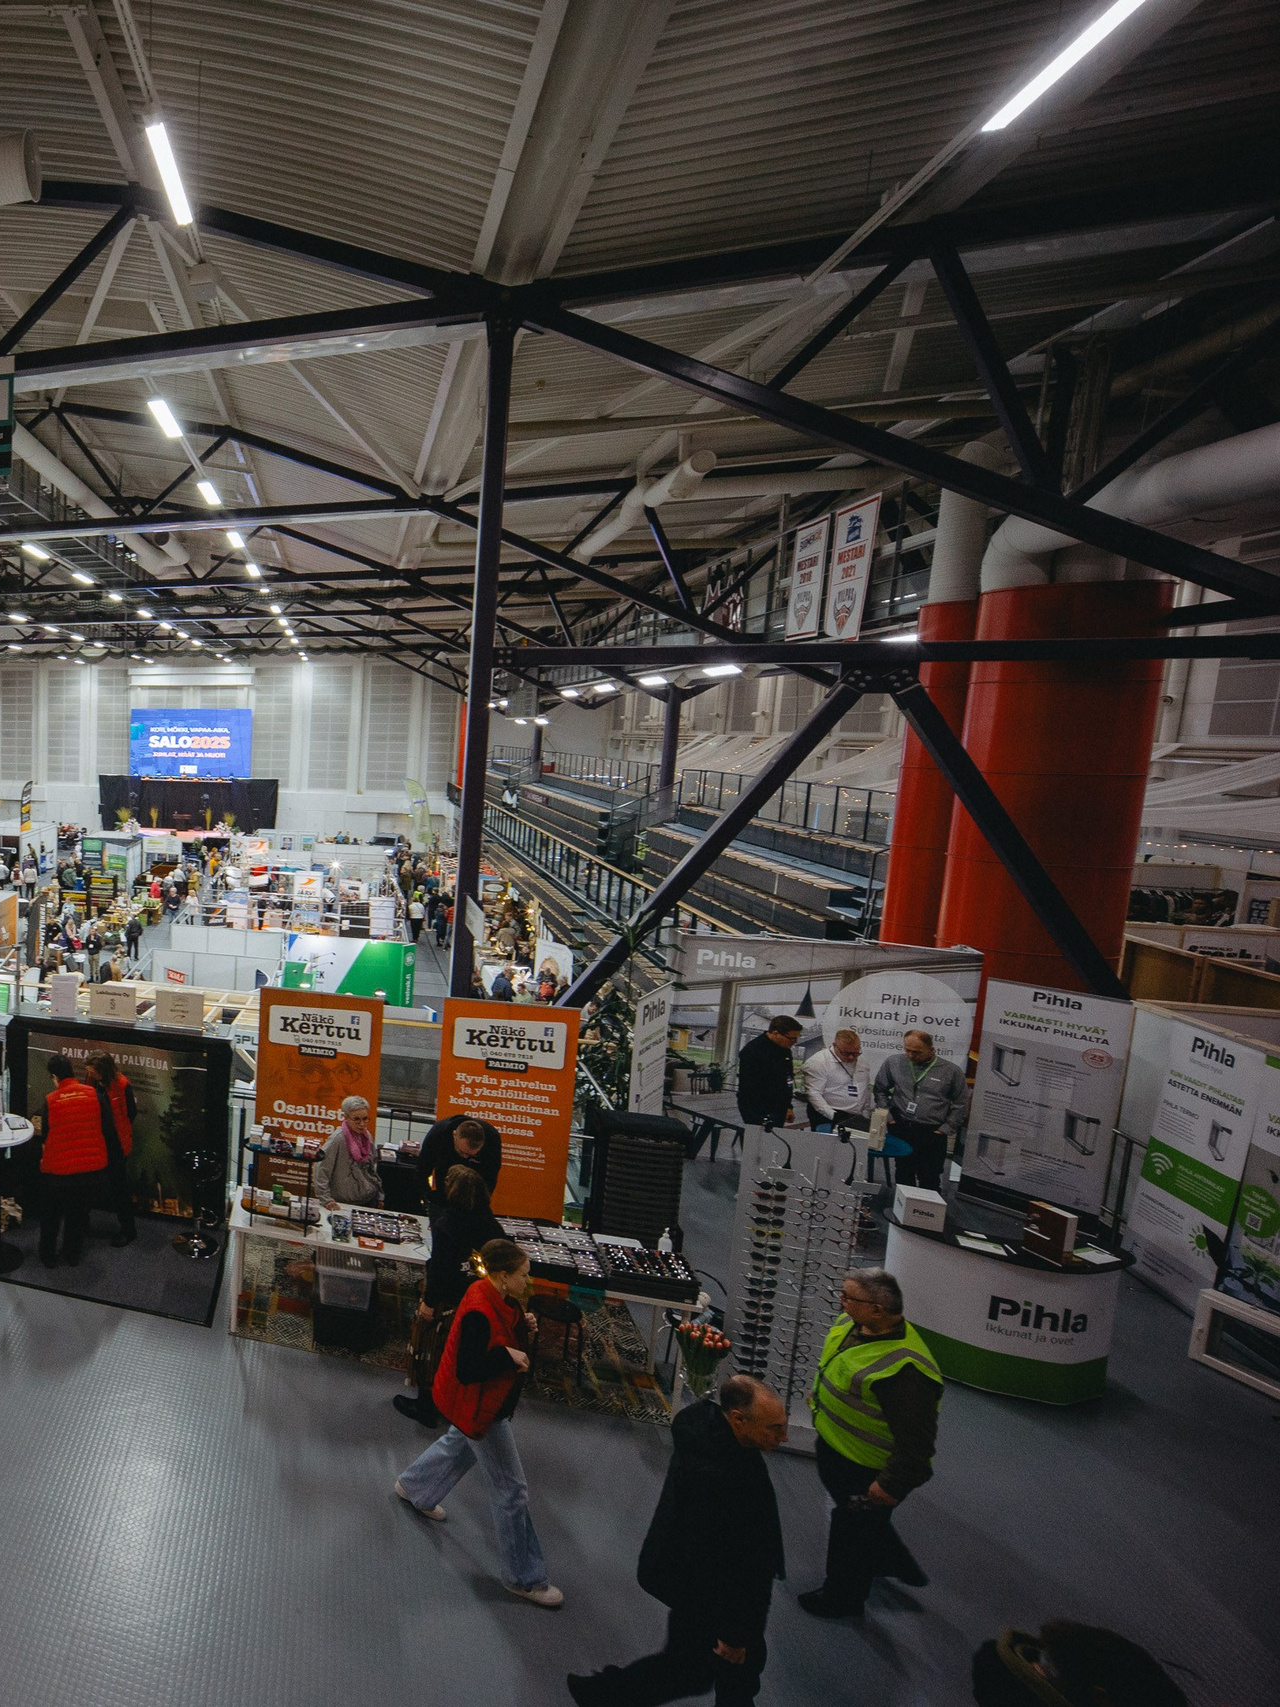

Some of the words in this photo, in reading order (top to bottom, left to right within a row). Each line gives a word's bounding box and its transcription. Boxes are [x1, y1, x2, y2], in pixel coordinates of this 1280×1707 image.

[837, 544, 866, 566] MESTARI
[148, 736, 230, 749] SALO2025
[697, 948, 756, 968] Pihla
[882, 993, 920, 1008] Pihla
[1032, 991, 1082, 1010] Pihla
[300, 1012, 334, 1024] Näkö
[642, 998, 666, 1026] Pihla
[839, 1006, 900, 1022] ikkunat
[902, 1010, 918, 1024] ja
[923, 1014, 960, 1028] ovet
[280, 1016, 362, 1041] Kerttu
[490, 1025, 526, 1037] Näkö
[850, 1025, 904, 1038] Suosituin
[1000, 1018, 1050, 1033] IKKUNAT
[1053, 1028, 1110, 1046] PIHLALTA
[1004, 1010, 1062, 1027] VARMASTI
[1065, 1022, 1108, 1036] HYVÄT
[300, 1046, 334, 1056] PAIMIO
[465, 1029, 555, 1054] Kerttu
[1090, 1054, 1104, 1063] 25
[1192, 1036, 1236, 1068] Pihla
[122, 1054, 168, 1071] PALVELUA
[488, 1060, 526, 1070] PAIMIO
[456, 1072, 498, 1086] Hyvän
[500, 1076, 557, 1092] palvelun
[1184, 1075, 1208, 1088] VAADIT
[1208, 1086, 1245, 1106] PIHLALTASI
[459, 1085, 472, 1096] ja
[474, 1086, 550, 1103] yksilöllisen
[1168, 1078, 1199, 1097] ASTETTA
[1200, 1092, 1242, 1116] ENEMMÄN
[449, 1096, 560, 1116] kehysvalikoiman
[1180, 1106, 1199, 1120] TERMO
[464, 1110, 542, 1126] optikkoliike
[912, 1208, 935, 1218] Pihla
[988, 1294, 1088, 1334] Pihla
[986, 1322, 1032, 1340] Ikkunat
[1035, 1331, 1046, 1343] ja
[1050, 1336, 1074, 1346] ovet
